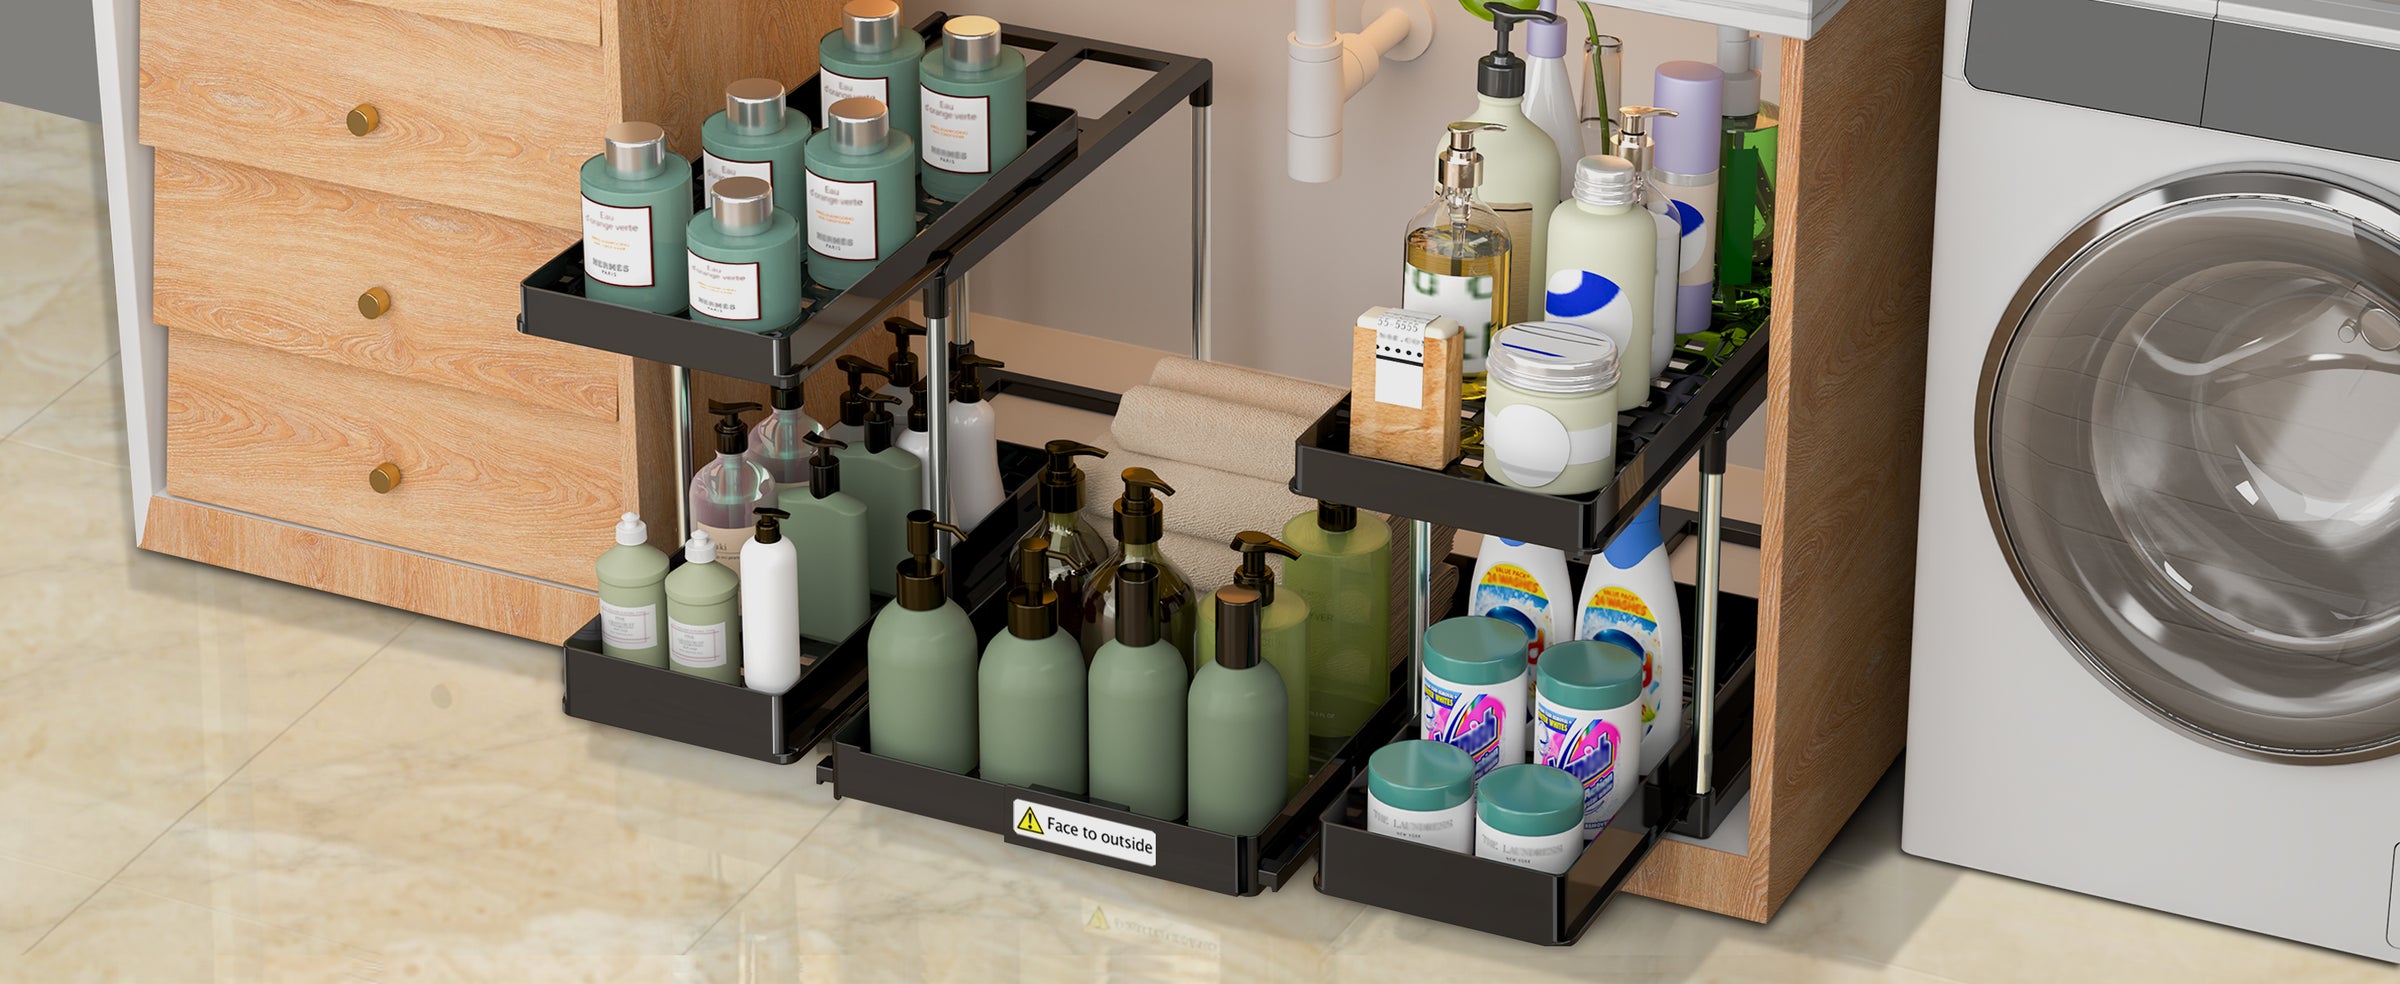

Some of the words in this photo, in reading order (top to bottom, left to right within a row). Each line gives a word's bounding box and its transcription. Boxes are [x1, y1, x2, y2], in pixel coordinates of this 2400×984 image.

[1486, 571, 1497, 583] 24
[1499, 574, 1539, 594] WASHES
[1494, 566, 1512, 576] VALUE
[1603, 589, 1619, 598] VALUE
[1594, 594, 1605, 606] 24
[1606, 596, 1648, 617] WASHES
[1048, 816, 1079, 837] Face
[1083, 827, 1098, 841] to
[1101, 832, 1153, 854] outside
